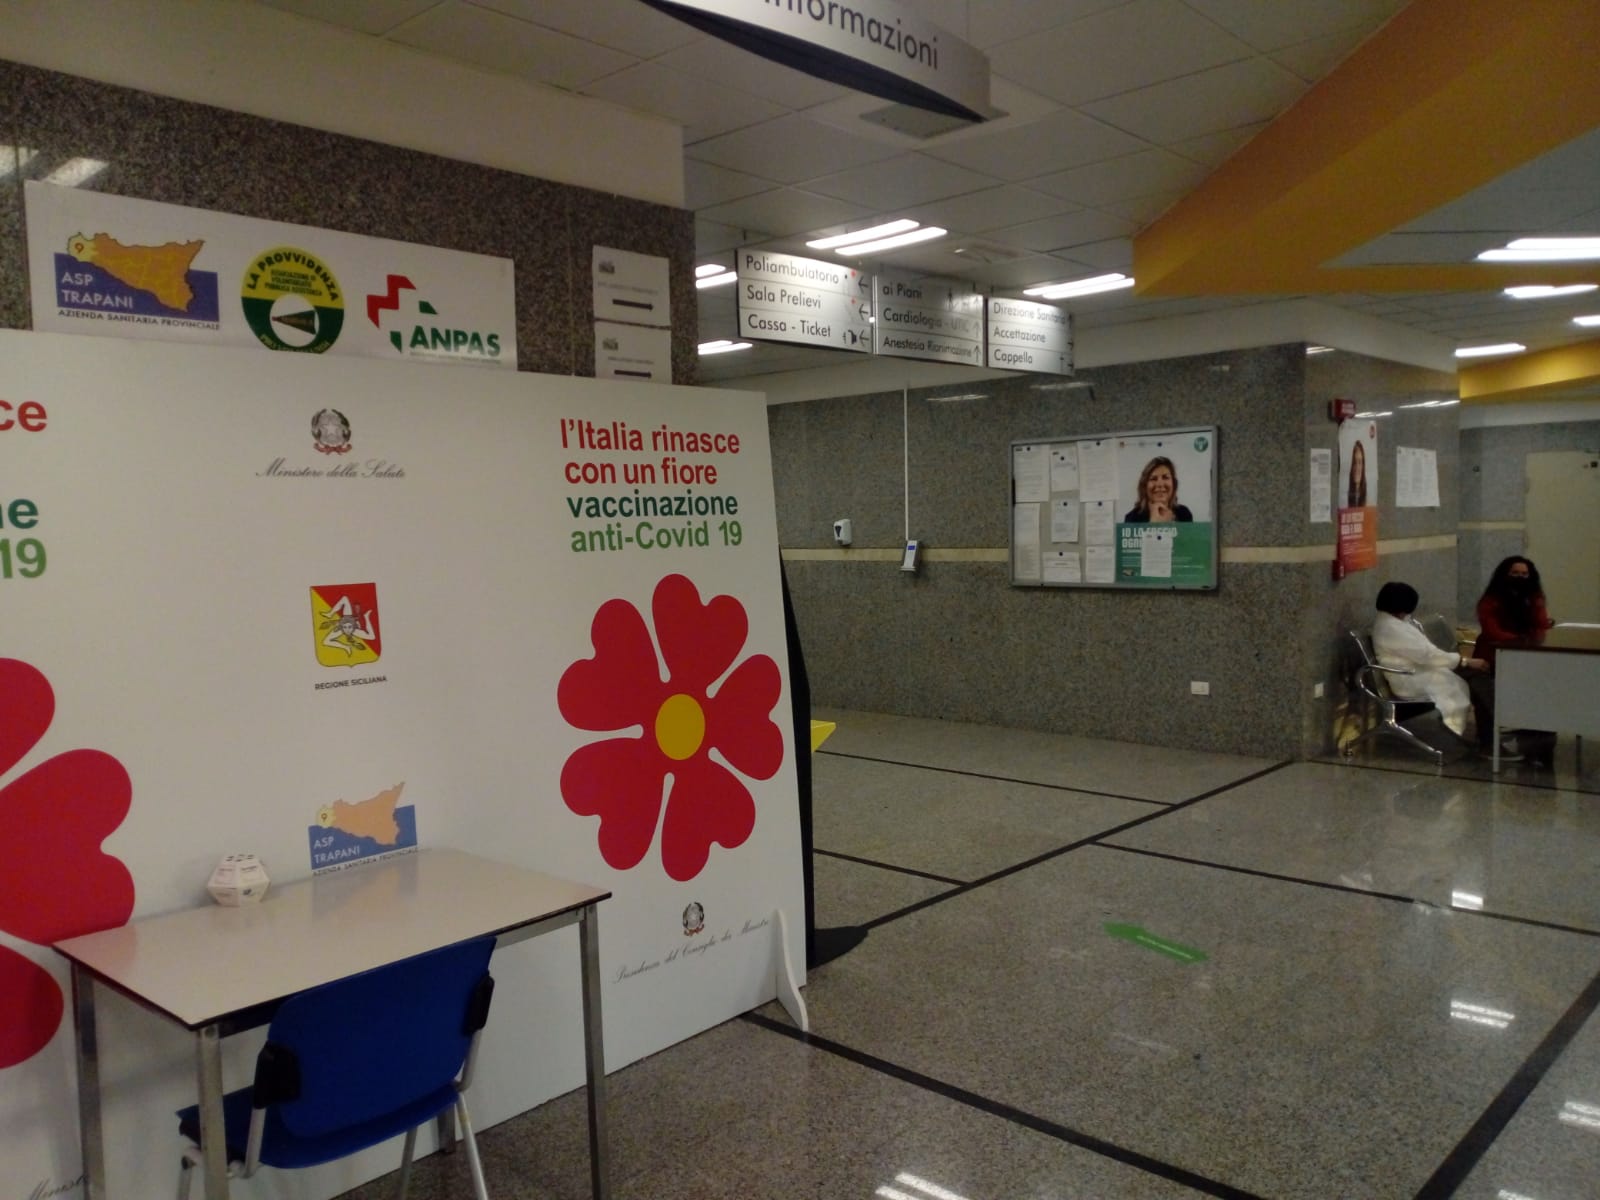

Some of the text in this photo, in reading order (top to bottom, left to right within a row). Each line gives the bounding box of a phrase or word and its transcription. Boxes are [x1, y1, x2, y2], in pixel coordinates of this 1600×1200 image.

[61, 271, 94, 286] ASP
[247, 252, 339, 302] LA PROVVIDENZA
[745, 254, 840, 285] Poliambulatorio
[62, 289, 134, 309] TRAPANI
[746, 284, 821, 309] Sala Prelievi
[882, 283, 922, 299] ai Piani
[58, 310, 220, 330] AZIENDA SANITARIA PROVINCIALE
[993, 301, 1035, 320] Direzione
[748, 313, 787, 332] Cassa
[799, 319, 831, 337] Ticket
[993, 327, 1046, 343] Accettazione
[409, 325, 501, 357] ANPAS
[883, 336, 925, 351] Anestesia
[994, 349, 1033, 365] Cappella
[560, 418, 740, 454] l'Italia rinasce
[255, 457, 406, 478] Ministero della Salute
[564, 457, 718, 485] con un fiore
[566, 488, 738, 518] vaccinazione
[571, 520, 743, 552] anti-Covid 19
[315, 675, 387, 690] REGIONE SICILIANA
[313, 836, 334, 849] ASP
[314, 846, 360, 864] TRAPANI
